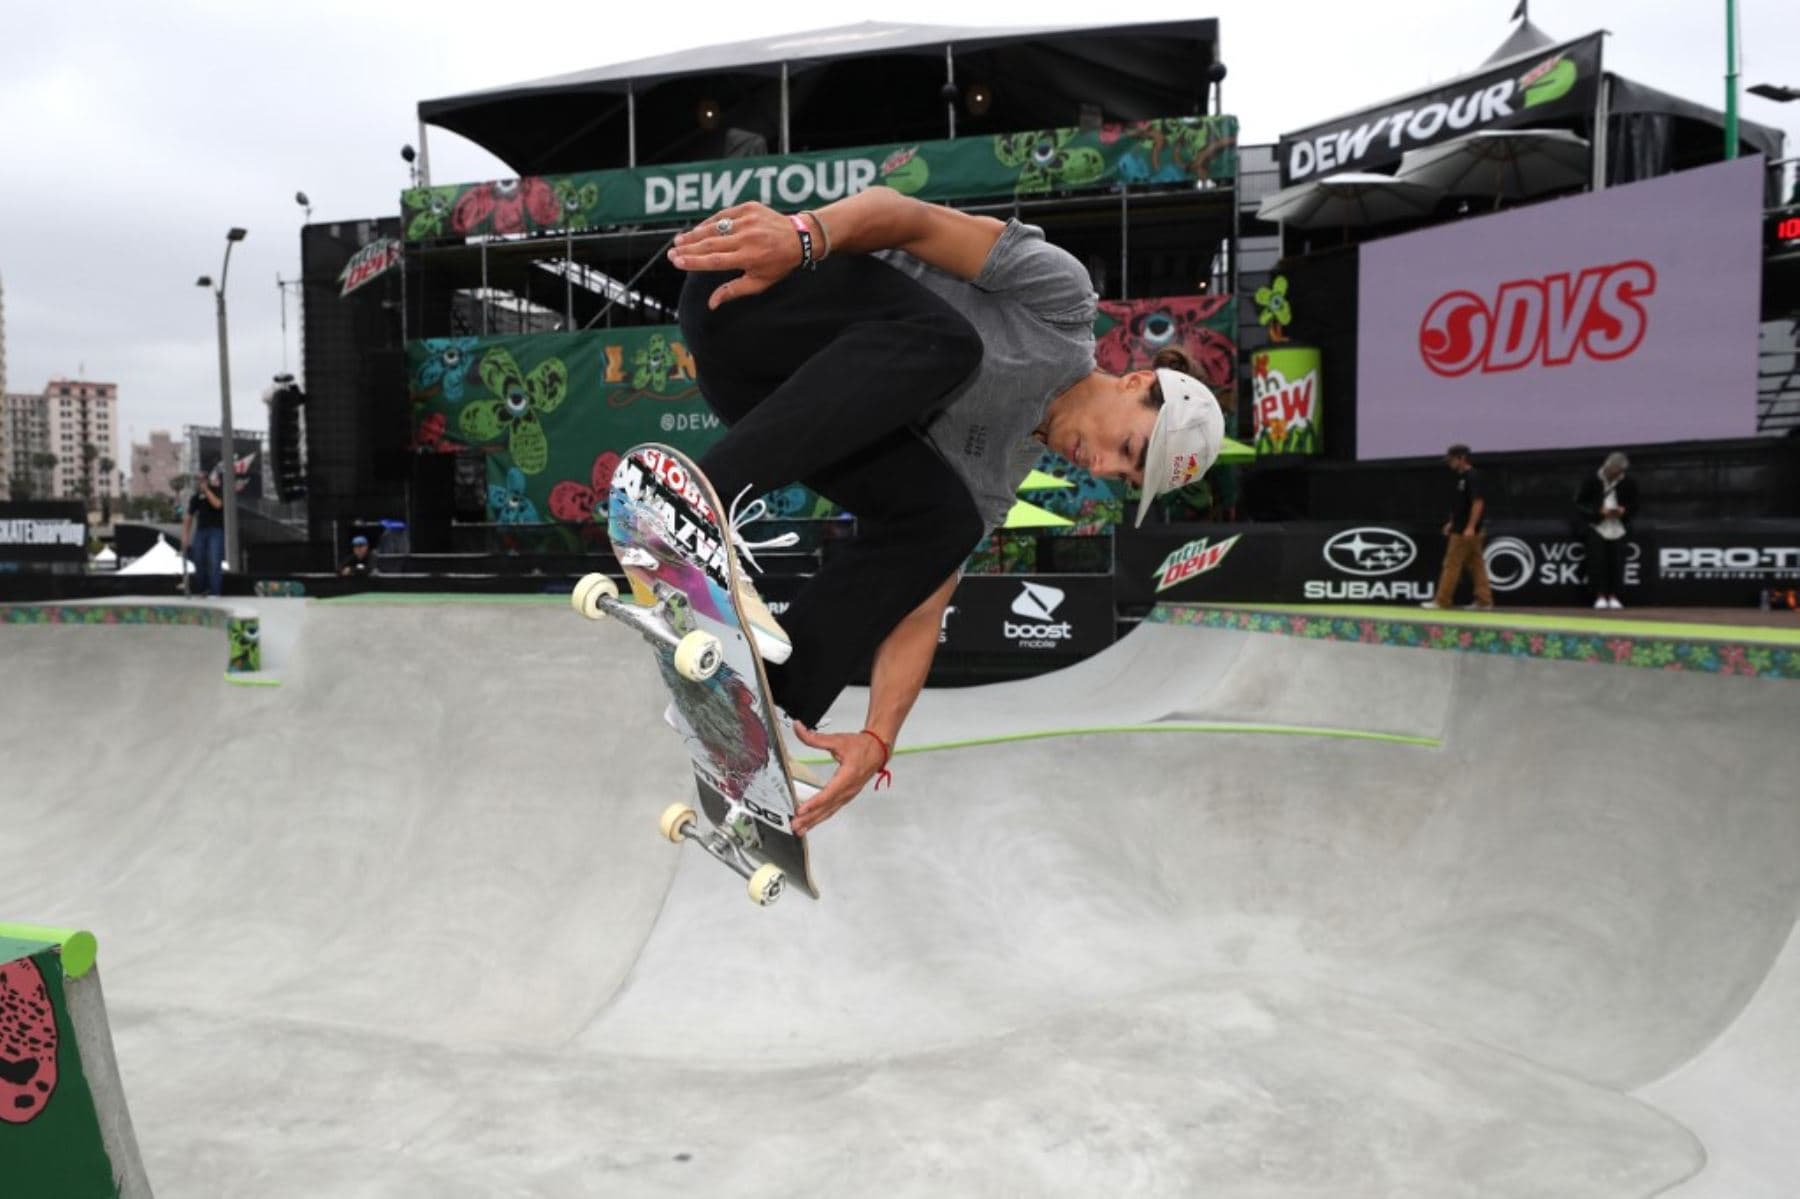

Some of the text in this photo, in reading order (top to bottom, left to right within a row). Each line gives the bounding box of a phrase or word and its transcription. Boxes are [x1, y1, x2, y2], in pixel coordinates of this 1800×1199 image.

[1480, 259, 1658, 374] DVS
[1541, 542, 1641, 561] WOD
[1660, 548, 1800, 567] PRO-T
[1540, 563, 1641, 584] SKE
[1304, 580, 1434, 598] SUBARU
[1004, 620, 1072, 638] boost
[1019, 639, 1056, 648] mobile
